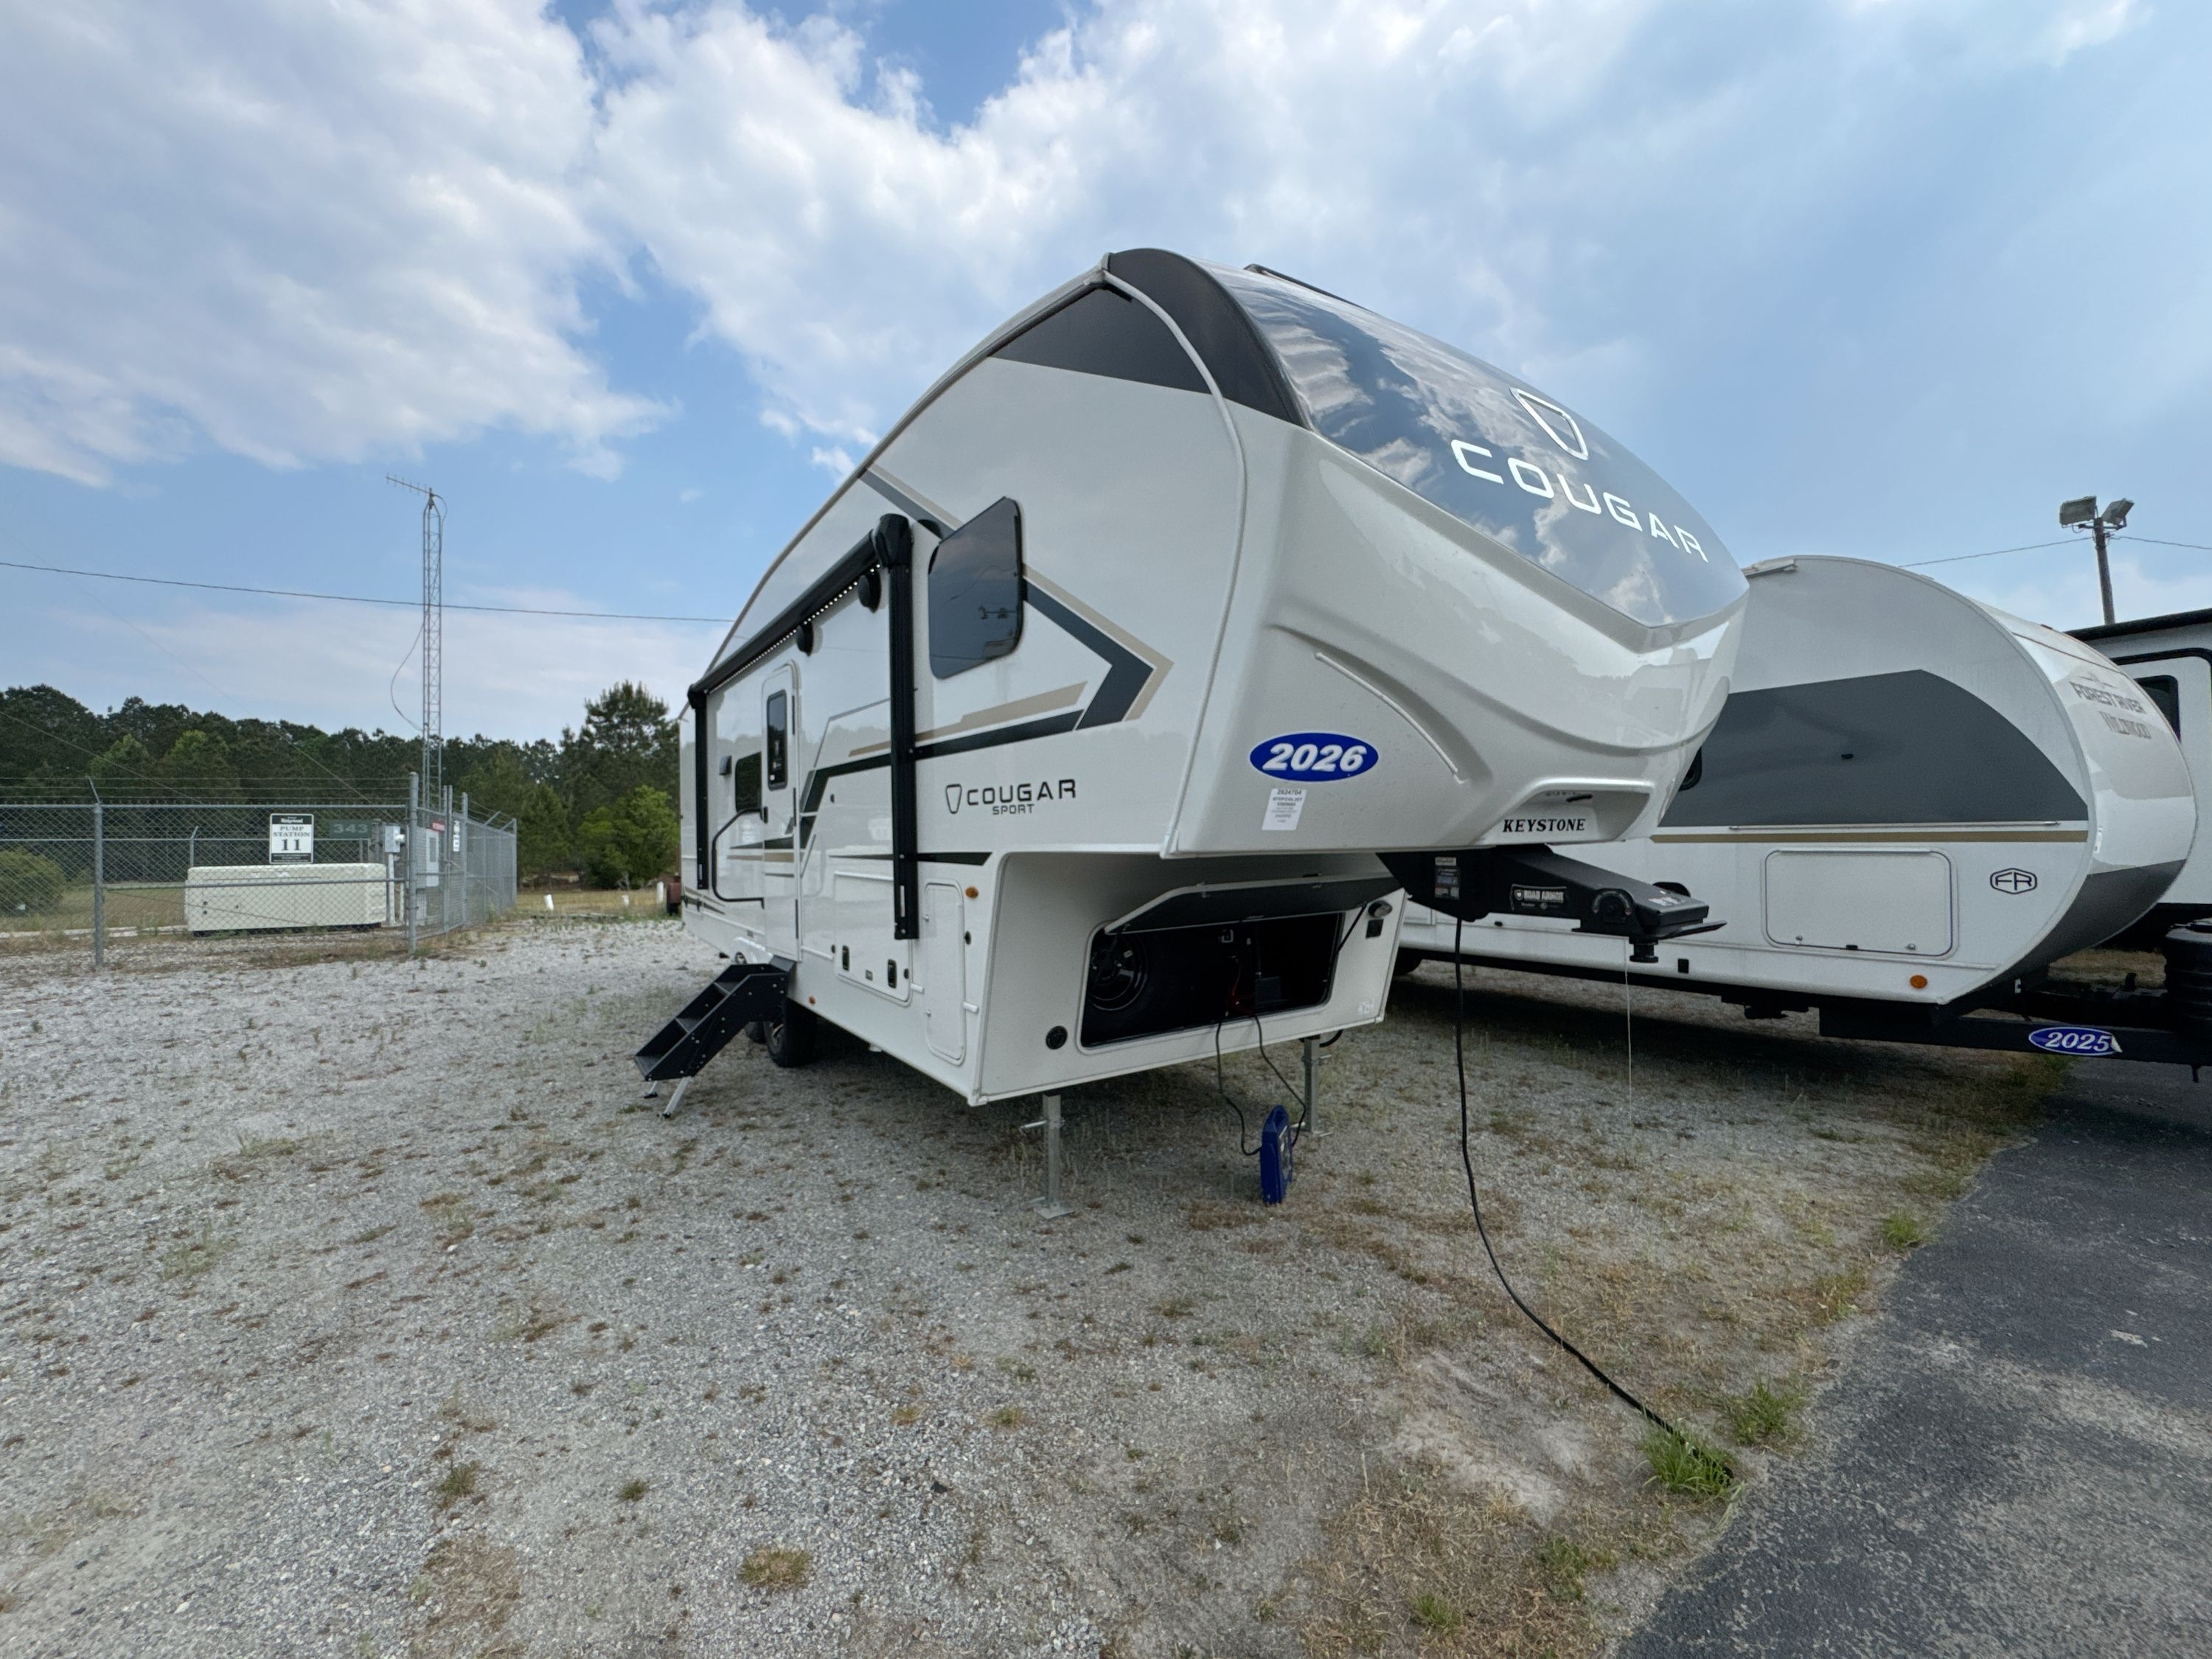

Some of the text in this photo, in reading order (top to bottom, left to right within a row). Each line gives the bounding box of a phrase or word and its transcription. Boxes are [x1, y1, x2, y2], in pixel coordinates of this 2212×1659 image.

[1450, 439, 1709, 563] COUGAR
[1262, 742, 1368, 772] 2026
[967, 779, 1077, 806] COUGAR
[992, 804, 1035, 815] SPORT
[333, 824, 369, 834] 343
[1503, 818, 1586, 832] KEYSTONE
[281, 838, 302, 851] 11
[2045, 1032, 2112, 1052] 2025
